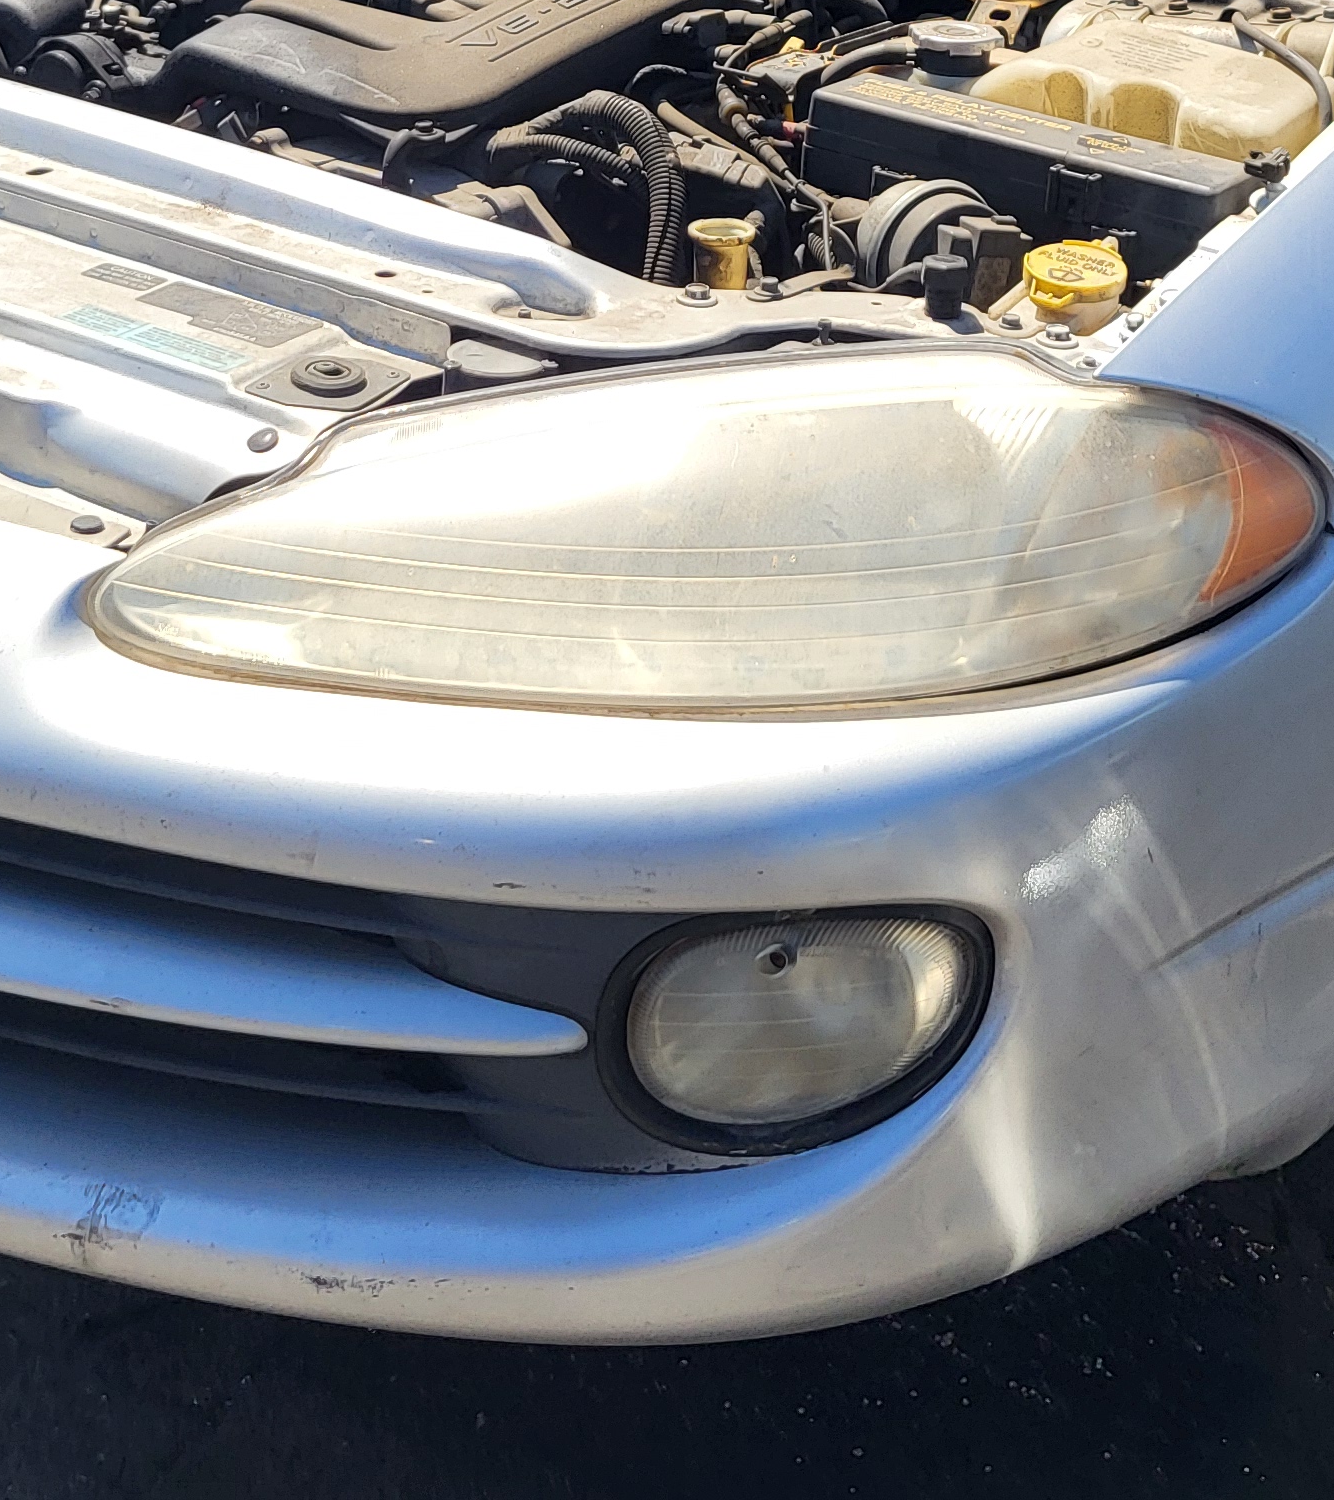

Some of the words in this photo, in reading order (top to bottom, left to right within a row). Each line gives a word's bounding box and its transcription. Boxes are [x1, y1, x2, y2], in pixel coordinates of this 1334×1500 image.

[930, 94, 992, 110] RELAY
[995, 109, 1072, 132] CENTER
[1038, 250, 1079, 266] FLUID
[1082, 263, 1119, 277] ONLY
[1056, 247, 1116, 269] WASHER
